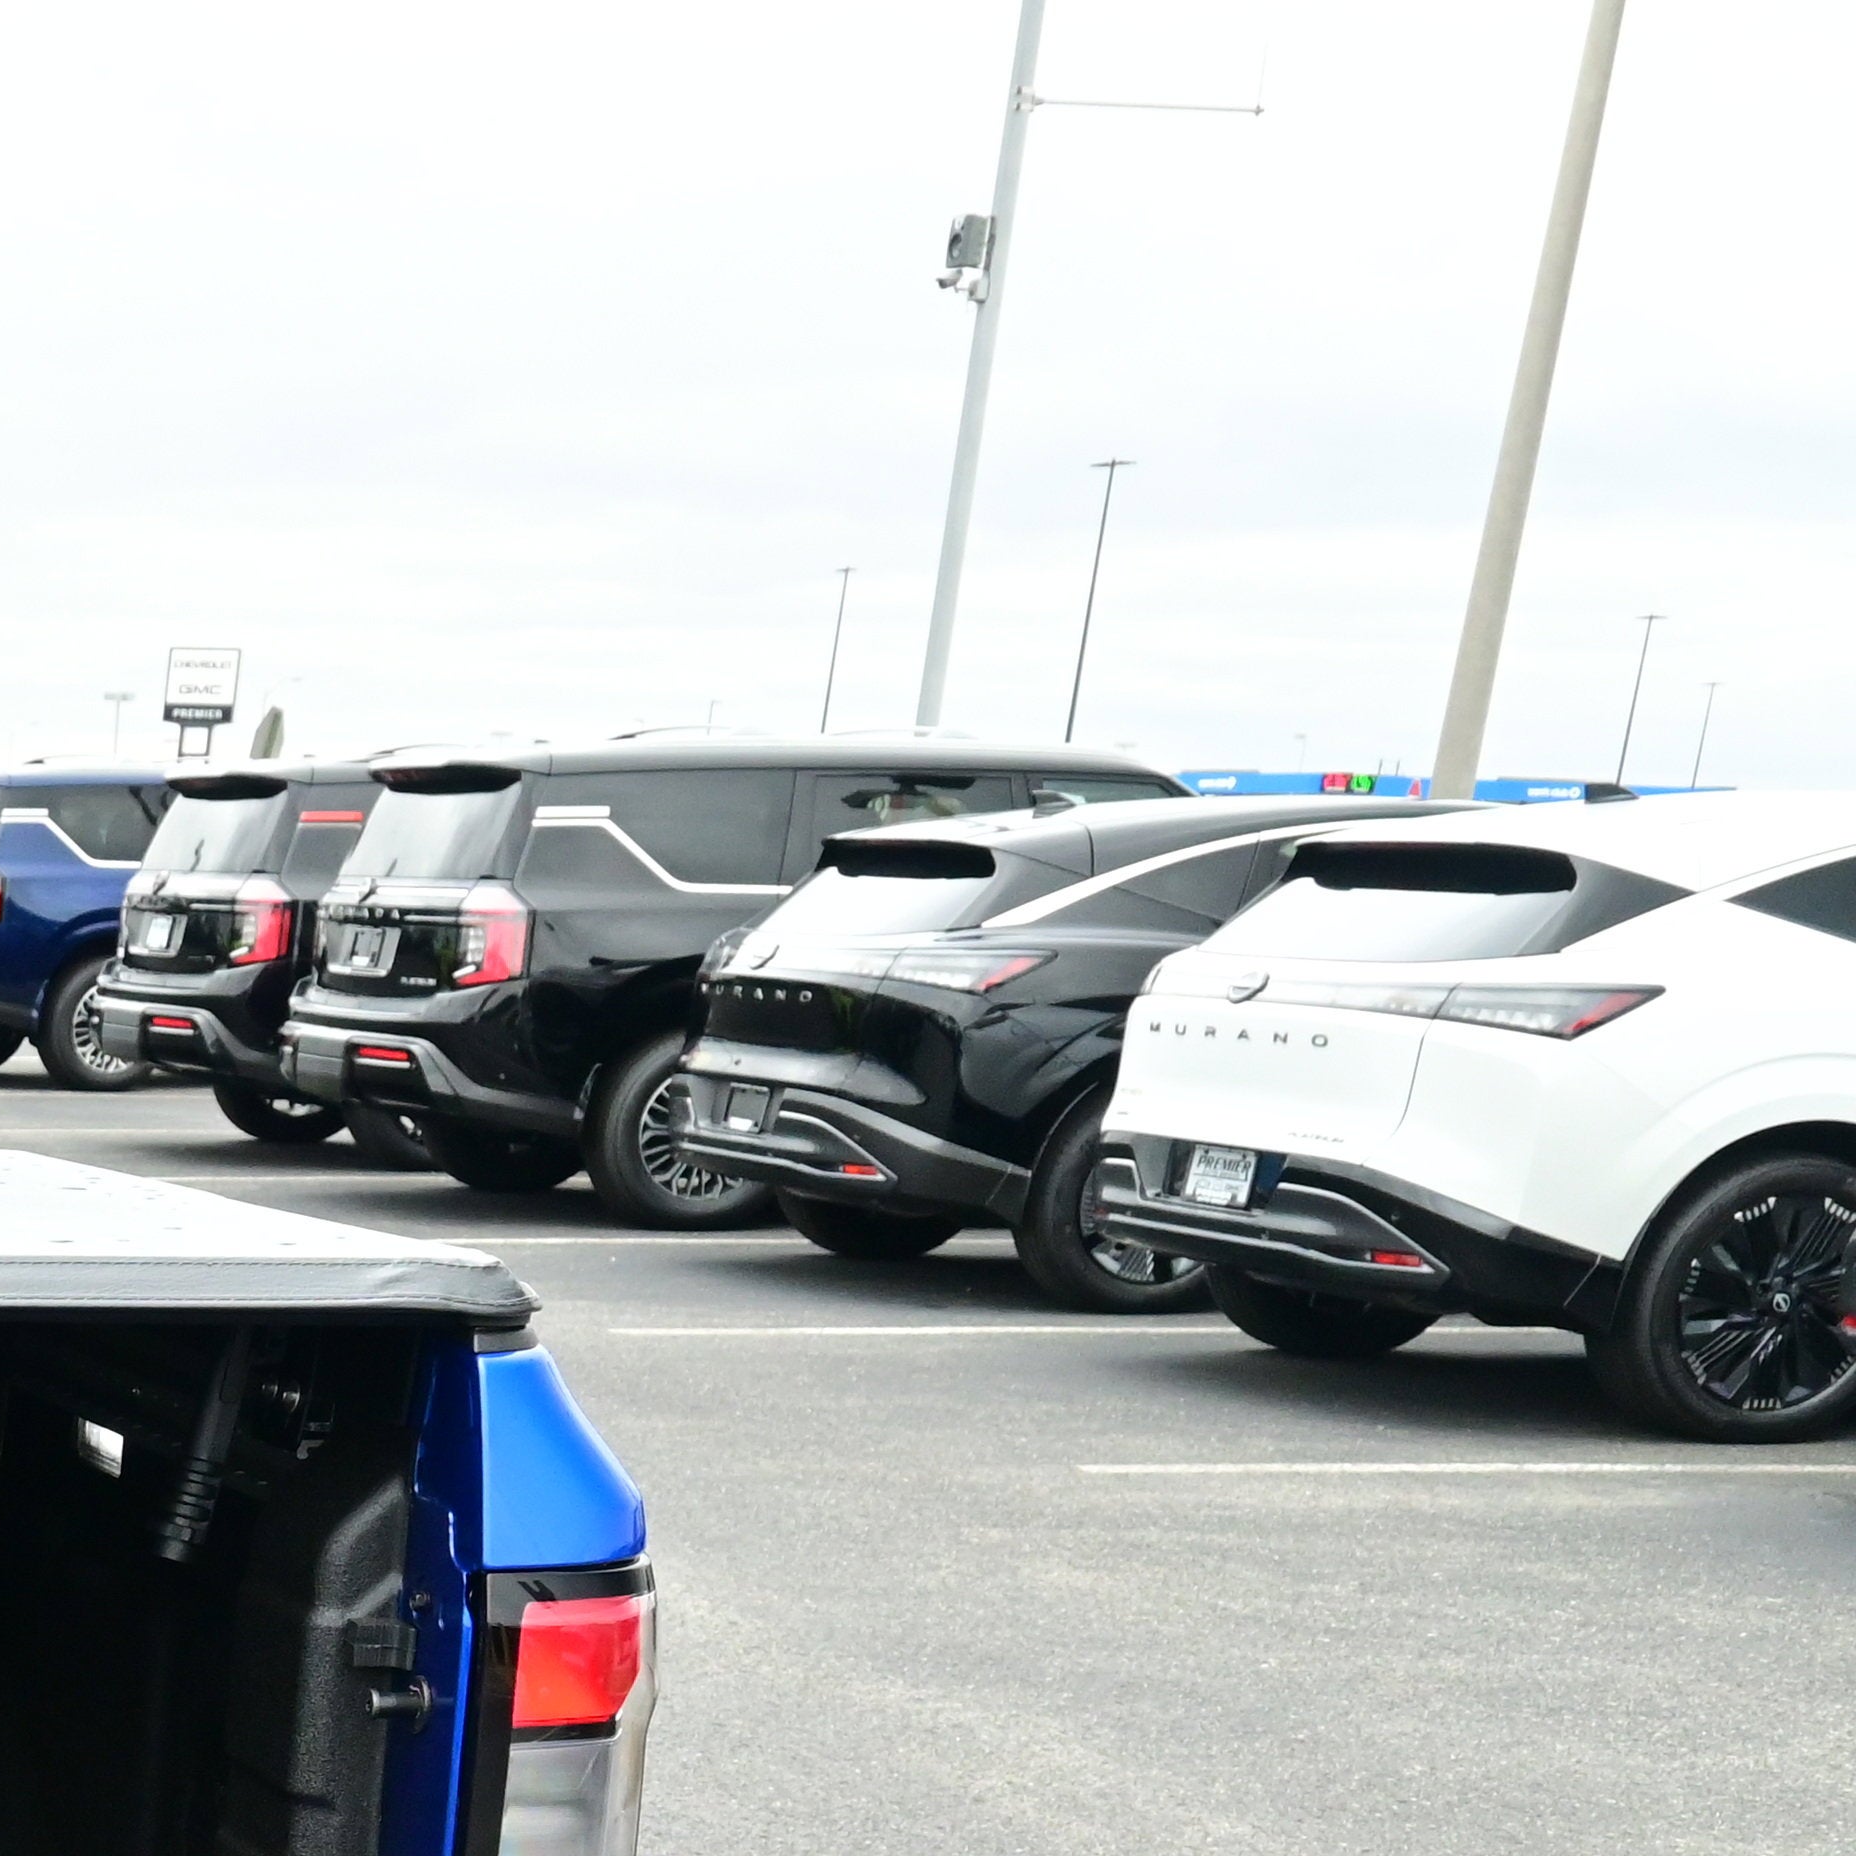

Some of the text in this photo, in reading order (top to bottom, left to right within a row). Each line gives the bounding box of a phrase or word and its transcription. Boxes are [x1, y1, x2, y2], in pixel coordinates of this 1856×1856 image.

[178, 684, 223, 695] GMC
[172, 707, 223, 720] PREMIER
[1149, 1020, 1329, 1048] MURANO
[1196, 1153, 1252, 1174] PREMIER
